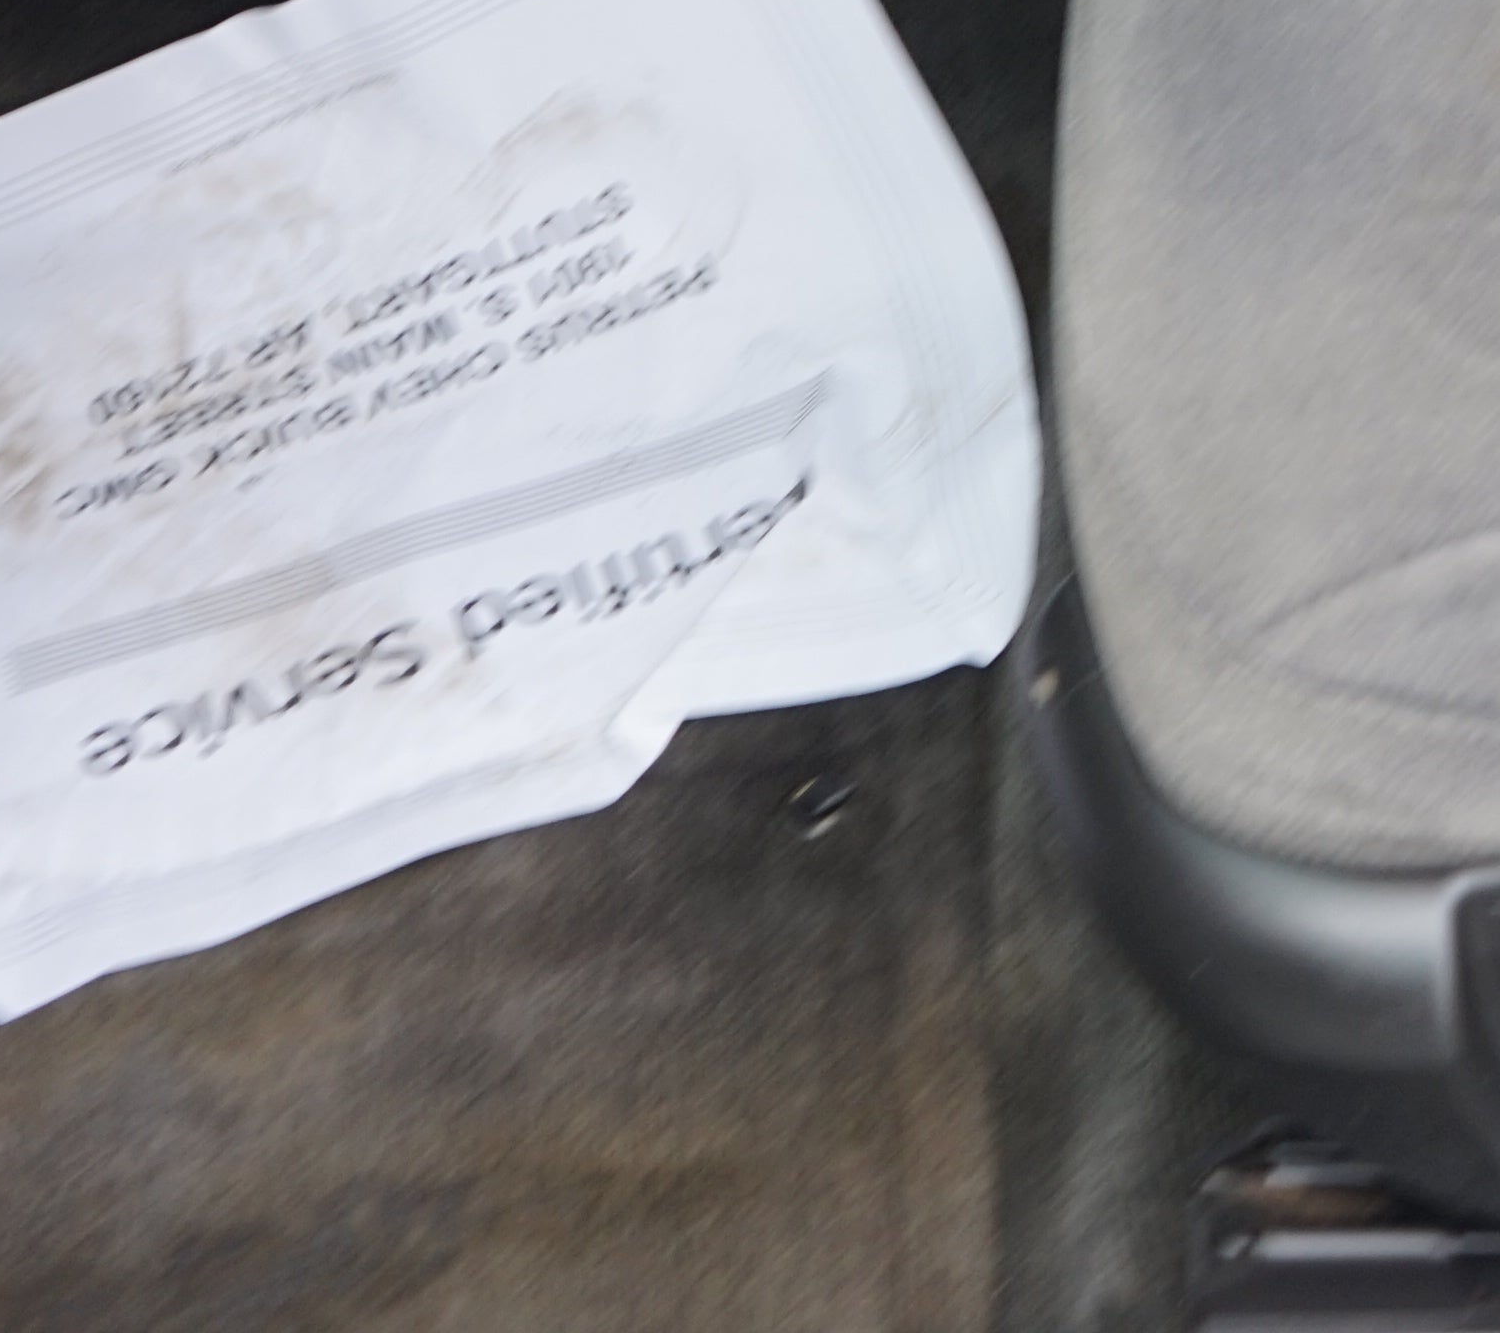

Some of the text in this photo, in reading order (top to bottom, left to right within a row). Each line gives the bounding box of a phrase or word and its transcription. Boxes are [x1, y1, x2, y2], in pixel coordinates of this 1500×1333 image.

[53, 252, 718, 521] PETRUS CHEV BUICK GMC
[237, 314, 313, 372] AR
[325, 309, 460, 386] MAIN
[116, 365, 320, 461] STREET
[78, 471, 810, 779] ertified Service
